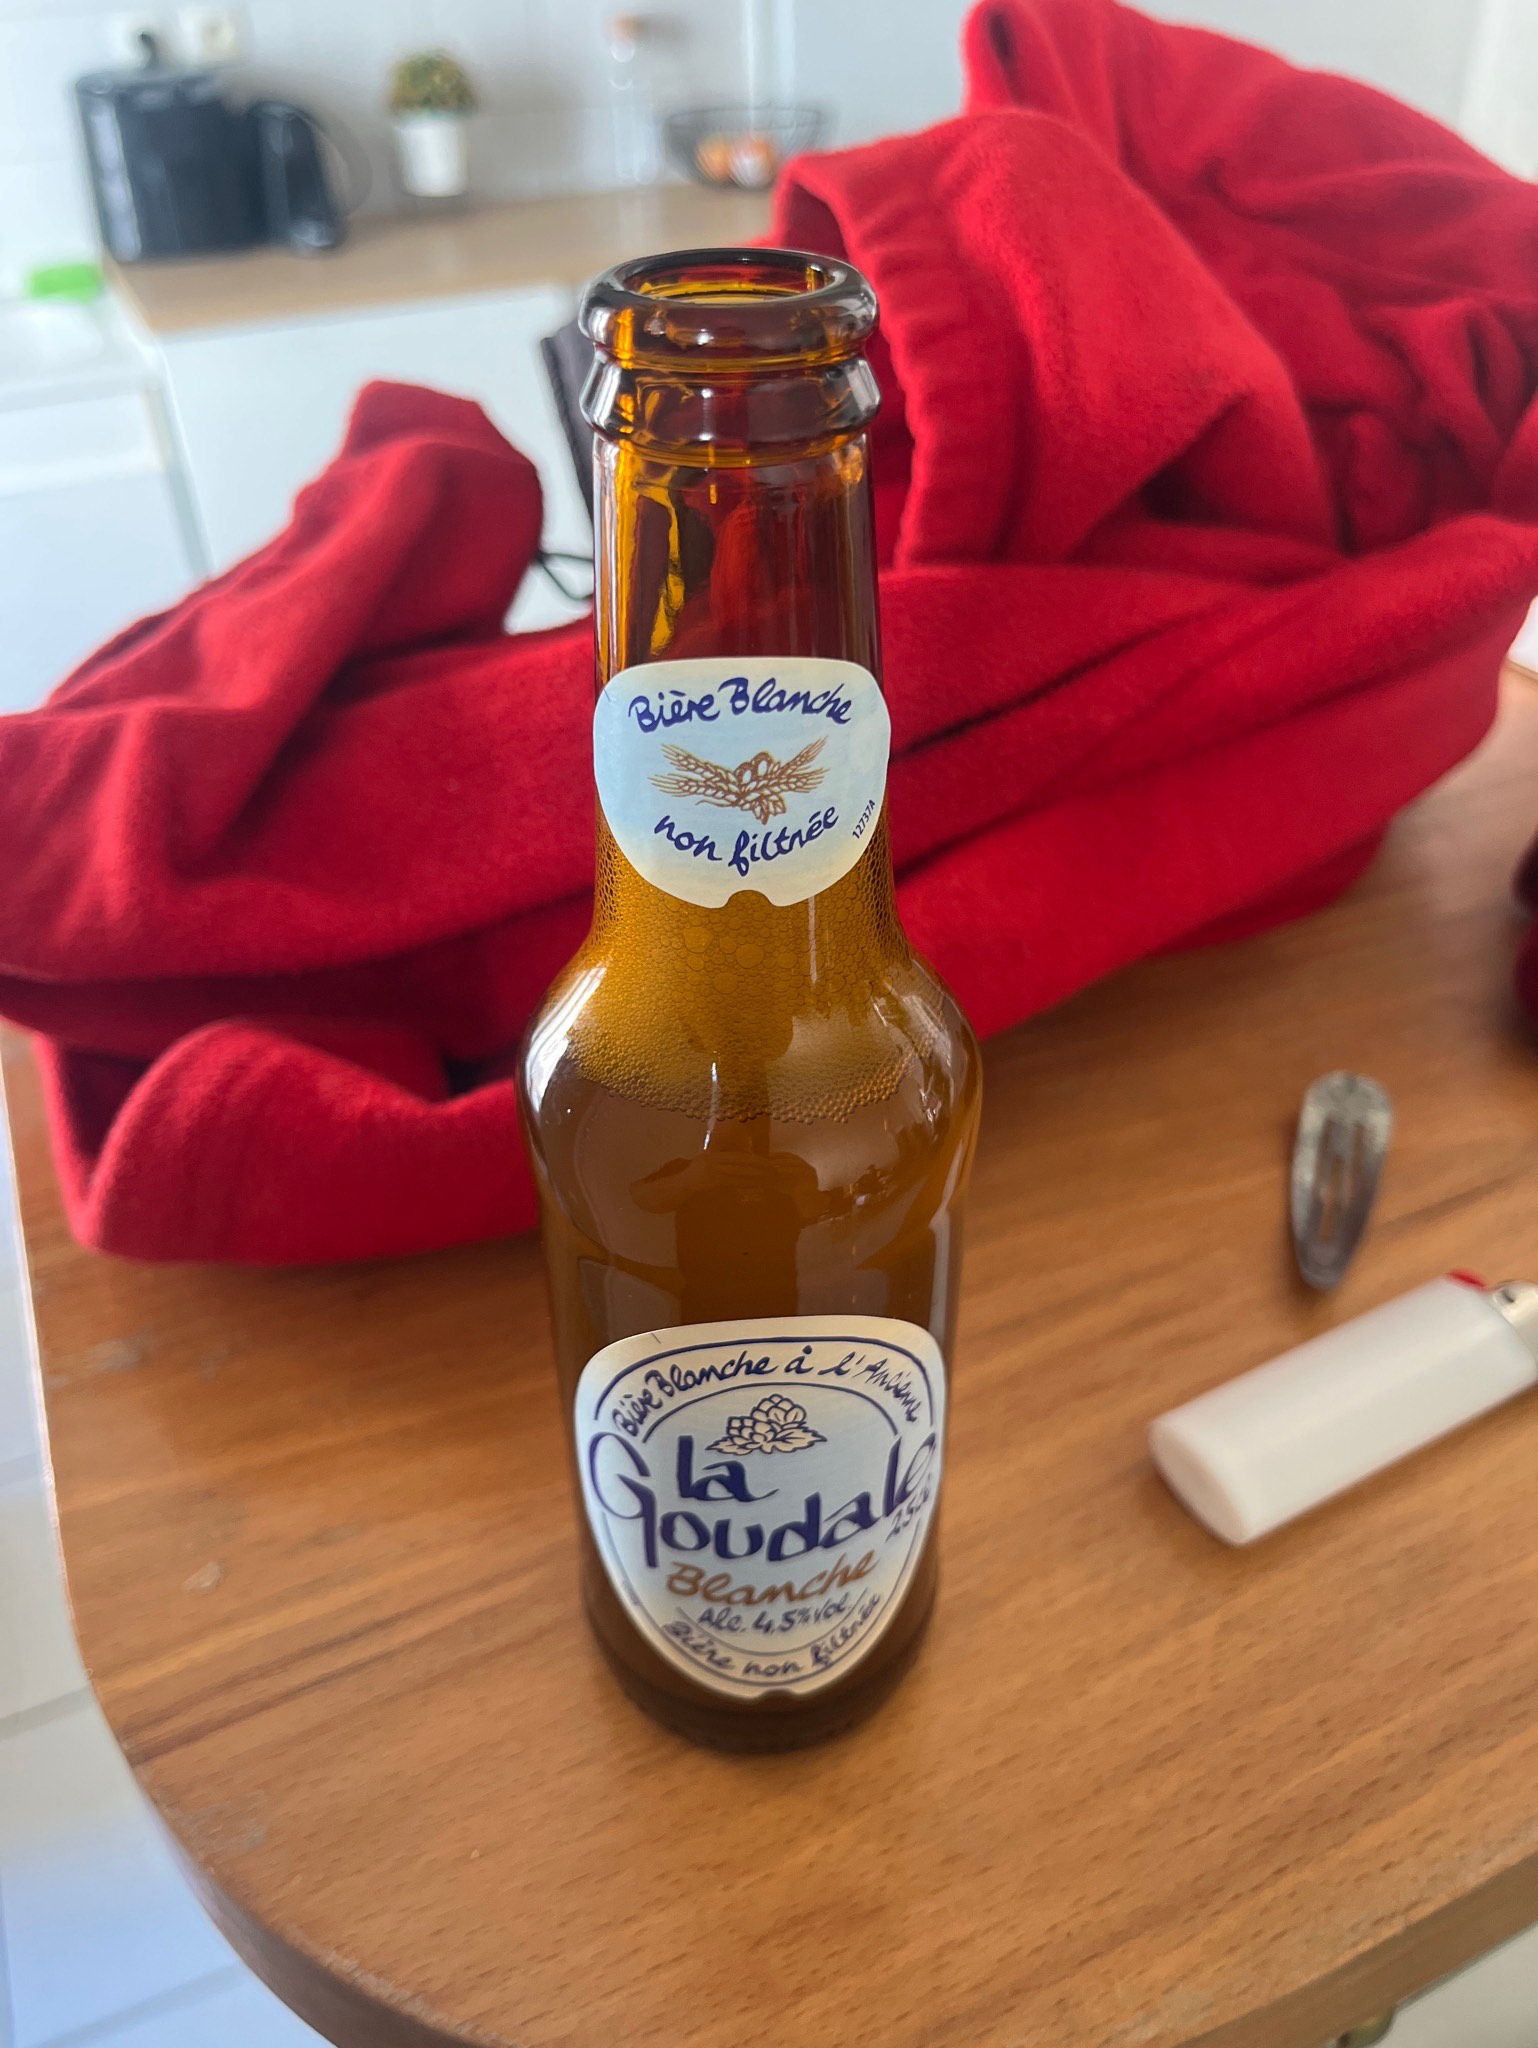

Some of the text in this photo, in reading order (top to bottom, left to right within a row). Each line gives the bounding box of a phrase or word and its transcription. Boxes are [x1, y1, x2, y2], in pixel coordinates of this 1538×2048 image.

[629, 677, 852, 733] Bière Blanche
[654, 806, 839, 877] non filtrée
[852, 799, 876, 839] 12737A
[611, 1393, 663, 1437] Bière
[645, 1350, 779, 1398] Blanche
[784, 1344, 814, 1375] à
[589, 1431, 936, 1568] Goudale
[664, 1550, 881, 1606] Blanche
[742, 1659, 803, 1677] non
